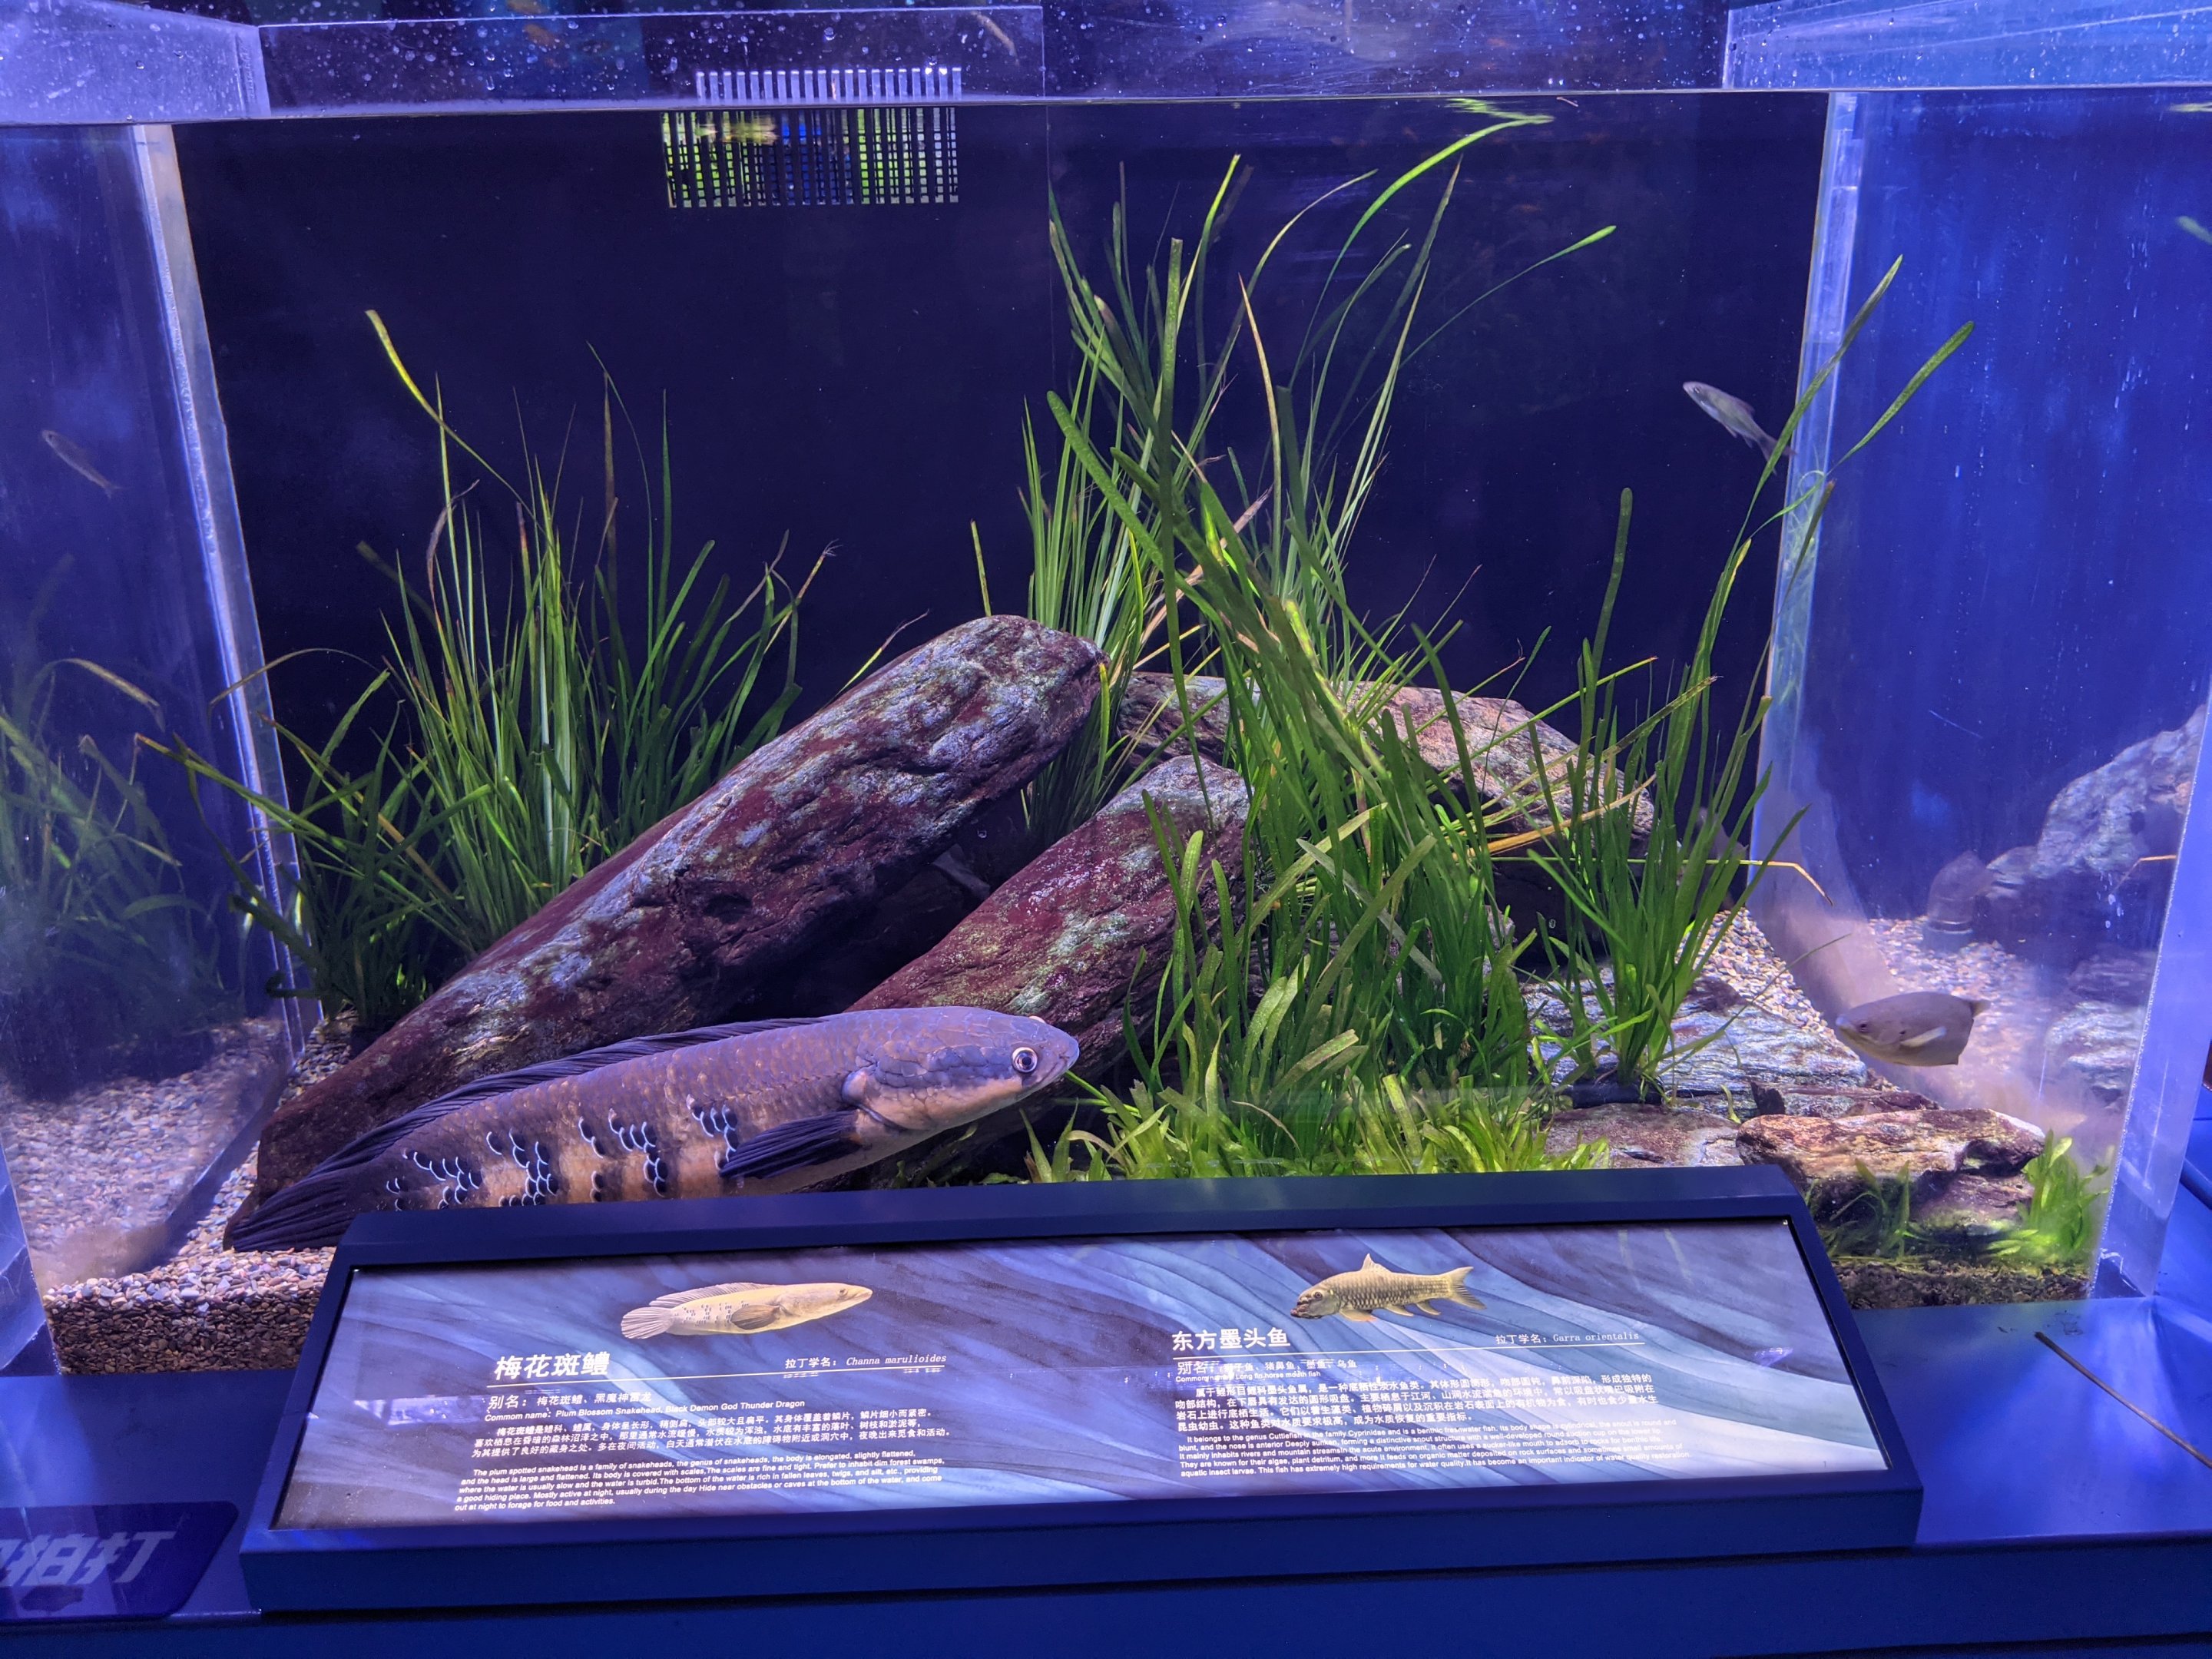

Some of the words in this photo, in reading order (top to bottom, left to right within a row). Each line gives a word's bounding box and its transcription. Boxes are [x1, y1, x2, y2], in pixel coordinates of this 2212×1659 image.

[1171, 1327, 1290, 1352] 东方墨头鱼
[1552, 1333, 1581, 1343] Garra
[1584, 1331, 1641, 1343] orientalis
[493, 1352, 611, 1380] 梅花斑鳢
[846, 1356, 882, 1367] Channa
[885, 1353, 948, 1366] marulioides
[555, 1410, 578, 1419] Plum
[578, 1409, 615, 1418] Blossom
[614, 1406, 664, 1417] Snakehead,
[665, 1406, 689, 1414] Black
[689, 1404, 720, 1413] Demon
[720, 1402, 739, 1412] God
[740, 1402, 775, 1411] Thunder
[775, 1400, 806, 1410] Dragon
[1193, 1434, 1223, 1445] belongs
[1231, 1432, 1245, 1442] the
[1244, 1434, 1269, 1442] genus
[1268, 1431, 1303, 1440] Cuttlefish
[1386, 1427, 1402, 1436] and
[1416, 1426, 1445, 1435] benthic
[1200, 1442, 1215, 1452] and
[1215, 1442, 1228, 1451] the
[1255, 1440, 1284, 1449] anterior
[1284, 1439, 1311, 1449] Deeply
[1375, 1435, 1413, 1445] distinctive
[1412, 1435, 1435, 1443] snout
[1180, 1459, 1200, 1469] They
[1199, 1459, 1213, 1468] are
[1213, 1458, 1238, 1467] known
[1237, 1457, 1250, 1466] for
[1249, 1457, 1268, 1465] their
[1291, 1455, 1311, 1465] plant
[1343, 1453, 1359, 1462] and
[1386, 1452, 1408, 1461] feeds
[1418, 1451, 1448, 1461] organic
[1185, 1451, 1211, 1461] mainly
[1210, 1450, 1240, 1459] inhabits
[1240, 1449, 1262, 1458] rivers
[1262, 1448, 1278, 1457] and
[1277, 1447, 1312, 1457] mountain
[1362, 1445, 1383, 1454] acute
[460, 1476, 478, 1485] and
[476, 1475, 492, 1485] the
[490, 1475, 512, 1485] head
[518, 1474, 540, 1485] large
[540, 1473, 556, 1482] and
[592, 1471, 604, 1480] Its
[603, 1471, 624, 1481] body
[631, 1469, 664, 1479] covered
[663, 1469, 680, 1477] with
[722, 1465, 747, 1475] scales
[762, 1464, 777, 1473] fine
[777, 1462, 793, 1472] and
[814, 1462, 839, 1471] Prefer
[848, 1460, 874, 1469] inhabit
[874, 1459, 889, 1468] dim
[889, 1459, 912, 1468] forest
[472, 1467, 489, 1476] The
[488, 1467, 509, 1477] plum
[508, 1465, 538, 1476] spotted
[537, 1464, 580, 1474] snakehead
[594, 1462, 618, 1472] family
[676, 1459, 690, 1468] the
[689, 1459, 714, 1469] genus
[772, 1454, 786, 1464] the
[785, 1454, 805, 1465] body
[853, 1451, 881, 1462] slightly
[1180, 1468, 1209, 1479] aquatic
[1208, 1467, 1232, 1476] insect
[1258, 1465, 1275, 1475] This
[1275, 1465, 1290, 1474] fish
[1290, 1464, 1305, 1473] has
[1304, 1463, 1342, 1474] extremely
[1341, 1462, 1359, 1473] high
[1359, 1461, 1408, 1472] requirements
[1406, 1460, 1419, 1469] for
[1419, 1460, 1441, 1469] water
[458, 1485, 485, 1494] where
[482, 1483, 498, 1493] the
[496, 1483, 520, 1492] water
[527, 1482, 556, 1492] usually
[556, 1481, 575, 1490] slow
[575, 1479, 591, 1489] and
[590, 1479, 604, 1488] the
[604, 1479, 627, 1488] water
[674, 1475, 702, 1485] bottom
[711, 1474, 726, 1483] the
[725, 1474, 748, 1483] water
[756, 1473, 772, 1482] rich
[780, 1472, 803, 1481] fallen
[855, 1468, 871, 1478] and
[904, 1466, 939, 1477] providing
[462, 1494, 485, 1504] good
[483, 1493, 509, 1503] hiding
[532, 1491, 559, 1502] Mostly
[558, 1489, 584, 1498] active
[615, 1487, 644, 1498] usually
[643, 1486, 669, 1496] during
[669, 1485, 683, 1494] the
[683, 1484, 698, 1495] day
[698, 1484, 717, 1493] Hide
[737, 1482, 773, 1491] obstacles
[783, 1481, 807, 1489] caves
[816, 1478, 830, 1488] the
[830, 1478, 857, 1487] bottom
[867, 1476, 880, 1485] the
[906, 1474, 921, 1484] and
[454, 1502, 469, 1512] out
[477, 1502, 499, 1512] night
[507, 1500, 534, 1511] forage
[545, 1499, 565, 1508] food
